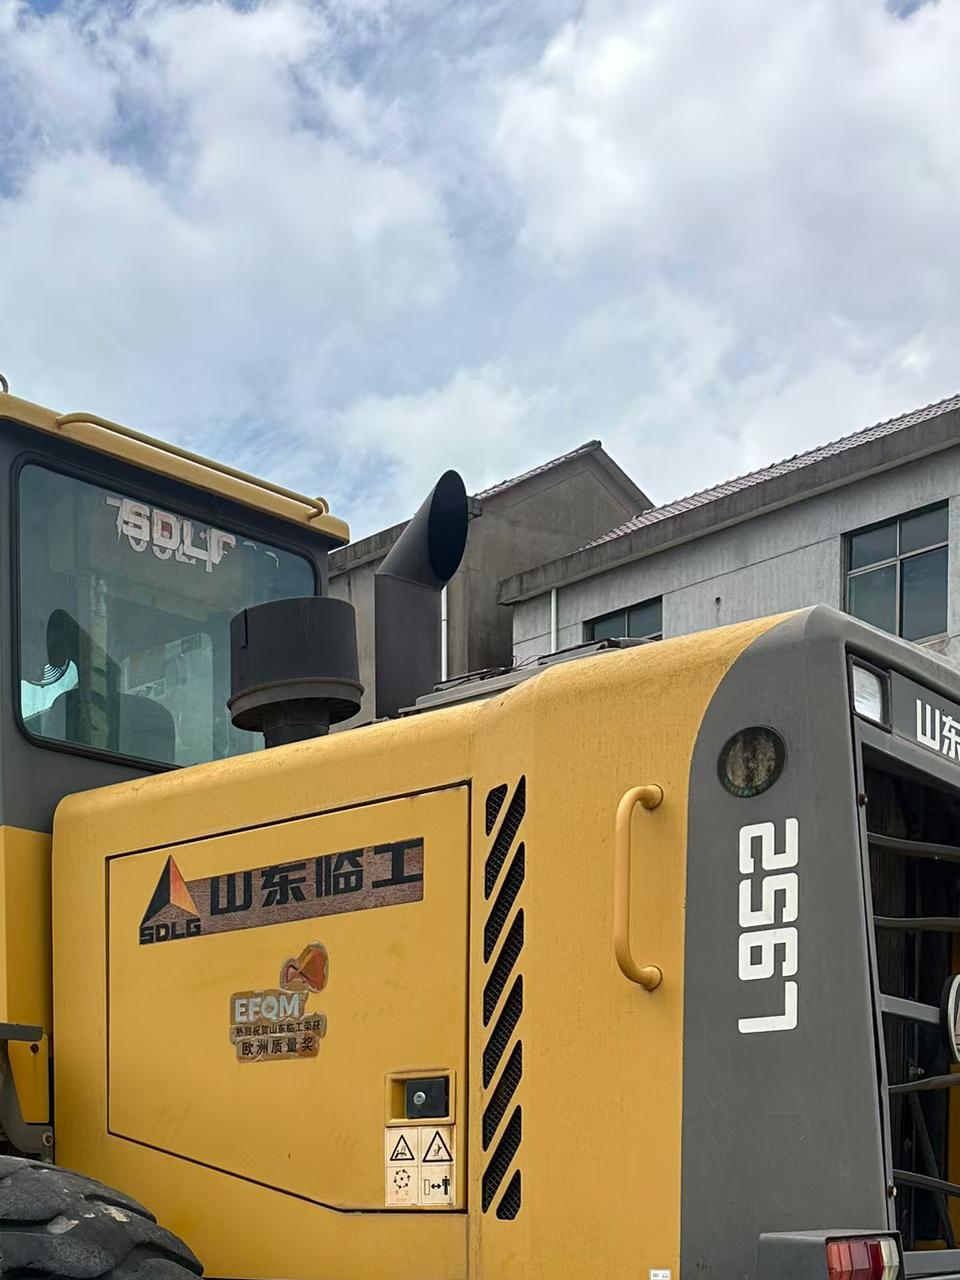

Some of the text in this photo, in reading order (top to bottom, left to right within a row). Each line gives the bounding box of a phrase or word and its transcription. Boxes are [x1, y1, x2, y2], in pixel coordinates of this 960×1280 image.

[916, 698, 960, 761] 山东
[210, 837, 424, 916] 山东临工
[140, 918, 201, 945] SDLG
[738, 817, 799, 1034] L952
[235, 993, 300, 1022] EFQM
[241, 1036, 314, 1056] 欧洲质量奖
